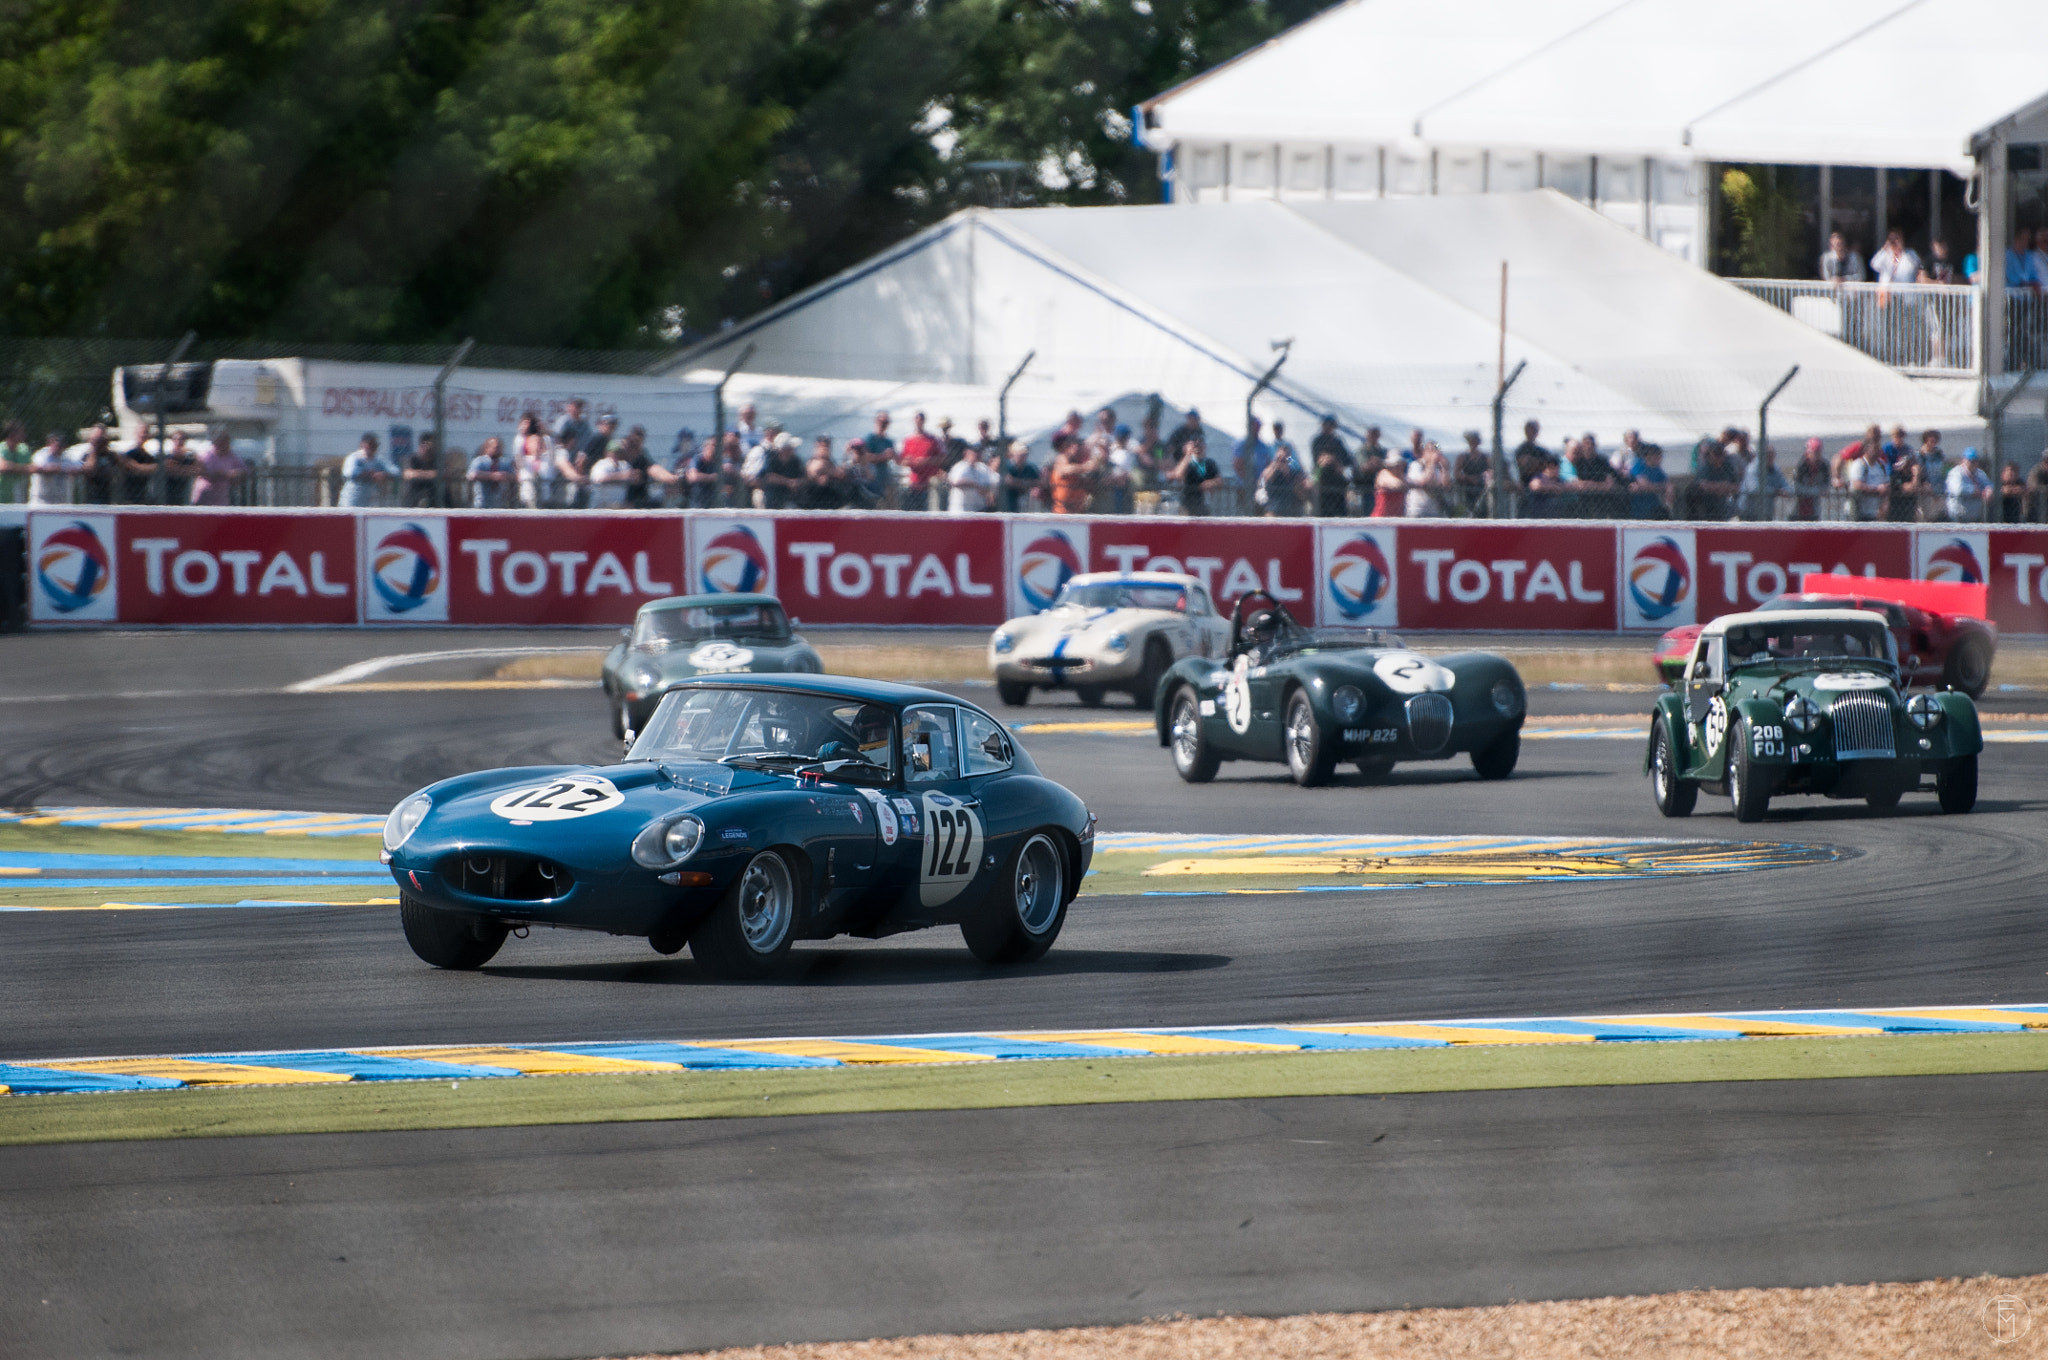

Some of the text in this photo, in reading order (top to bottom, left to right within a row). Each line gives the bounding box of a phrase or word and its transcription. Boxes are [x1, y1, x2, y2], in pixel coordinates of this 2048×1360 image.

[132, 539, 347, 596] TOTAL
[461, 540, 673, 596] TOTAL
[789, 542, 993, 598] TOTAL
[1411, 550, 1604, 602] TOTAL
[1392, 658, 1424, 679] 2
[1373, 728, 1398, 742] 825
[1754, 741, 1785, 757] FOJ
[504, 783, 611, 812] 122
[928, 809, 973, 877] 122
